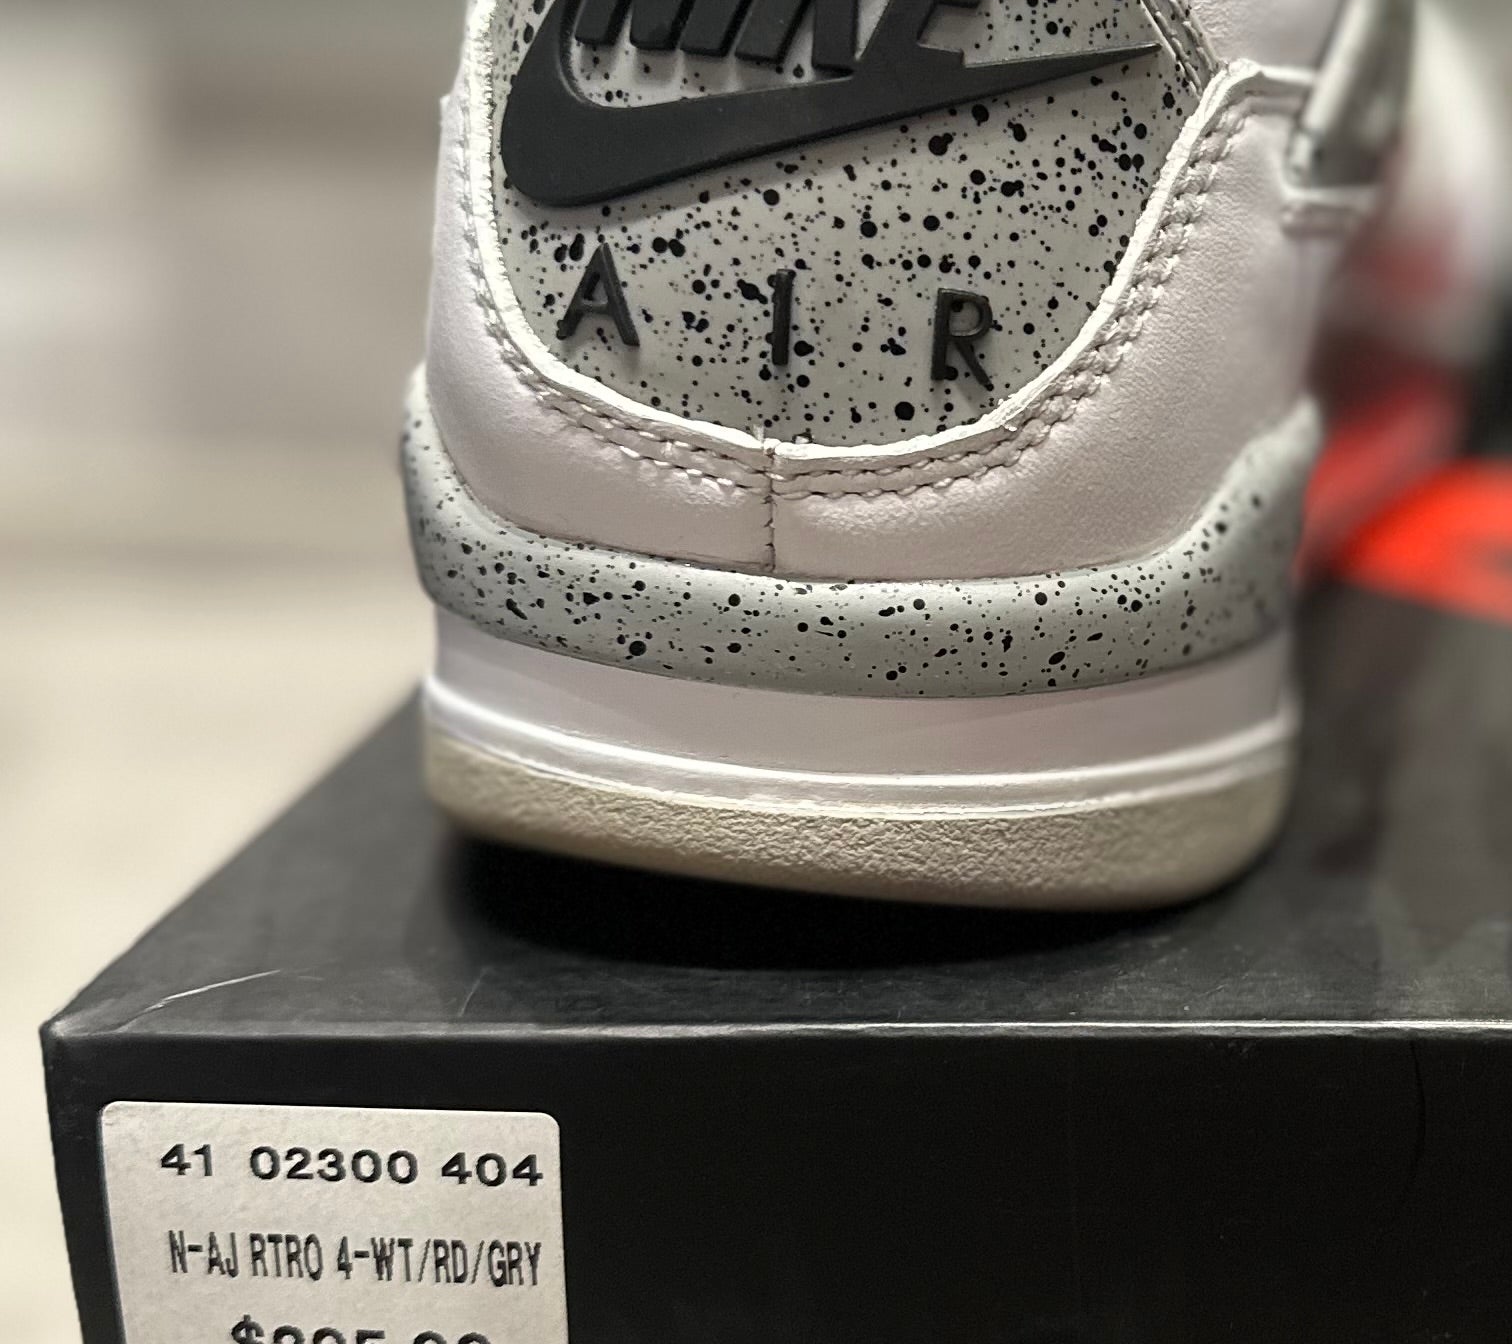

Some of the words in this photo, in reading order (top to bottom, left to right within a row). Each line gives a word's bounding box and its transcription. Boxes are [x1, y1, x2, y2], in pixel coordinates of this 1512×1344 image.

[557, 242, 994, 392] AIR
[160, 1143, 213, 1177] 41
[249, 1145, 419, 1185] 02300
[440, 1151, 543, 1187] 404
[168, 1229, 239, 1278] N-AJ
[249, 1231, 322, 1282] RTRO
[335, 1235, 542, 1288] 4-WT/RD/GRY
